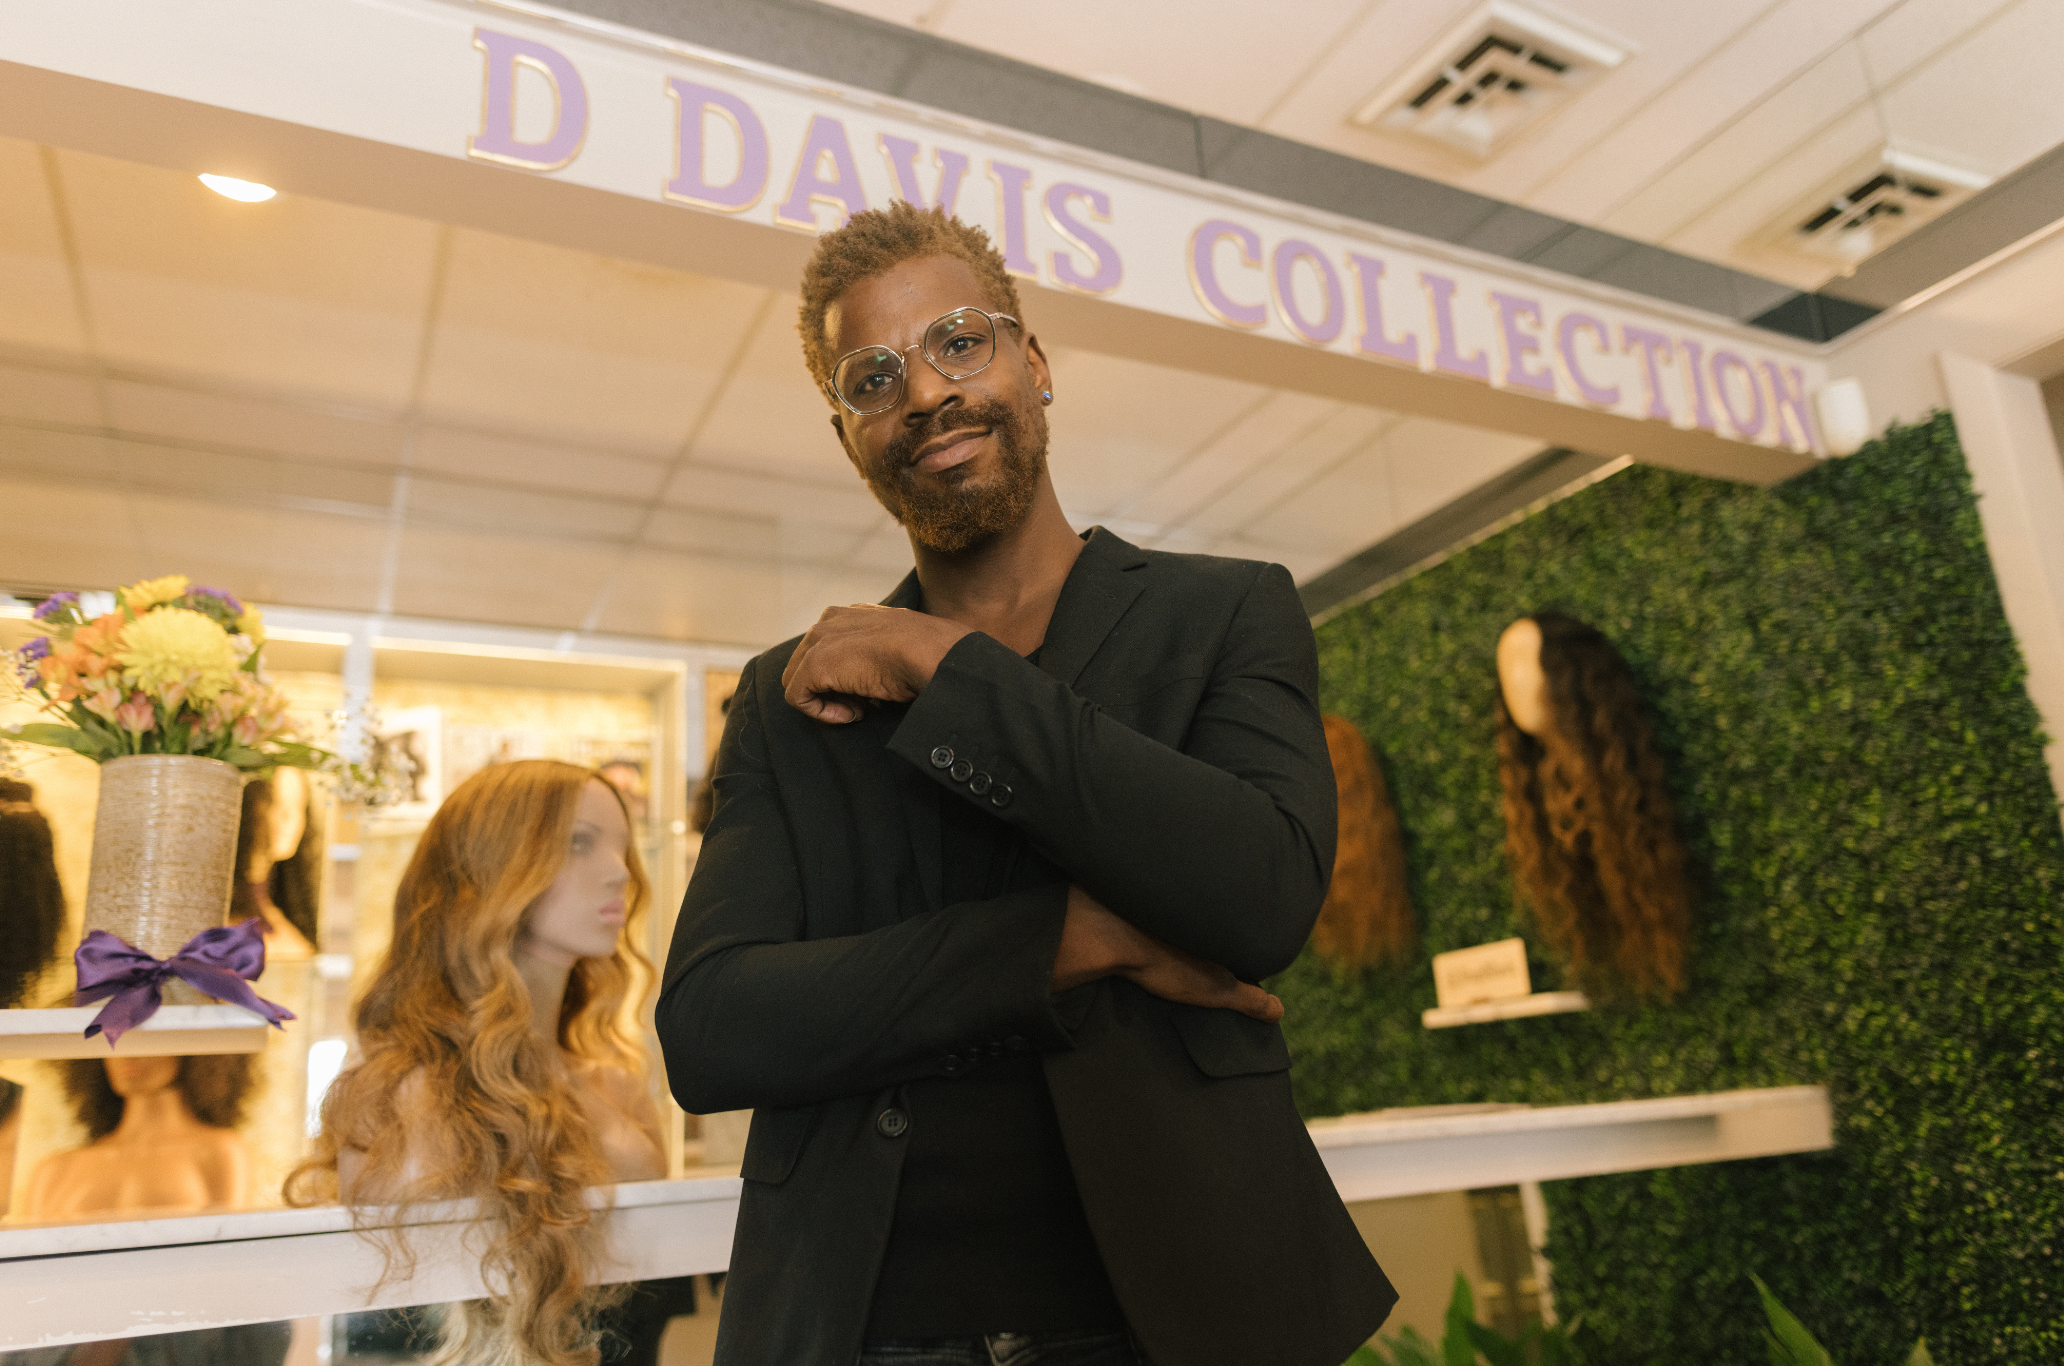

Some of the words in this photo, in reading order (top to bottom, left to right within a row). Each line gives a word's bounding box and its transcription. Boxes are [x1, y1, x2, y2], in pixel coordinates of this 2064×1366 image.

[467, 27, 589, 171] D
[663, 76, 1123, 294] DAVIS
[1187, 219, 1816, 453] COLLECTION
